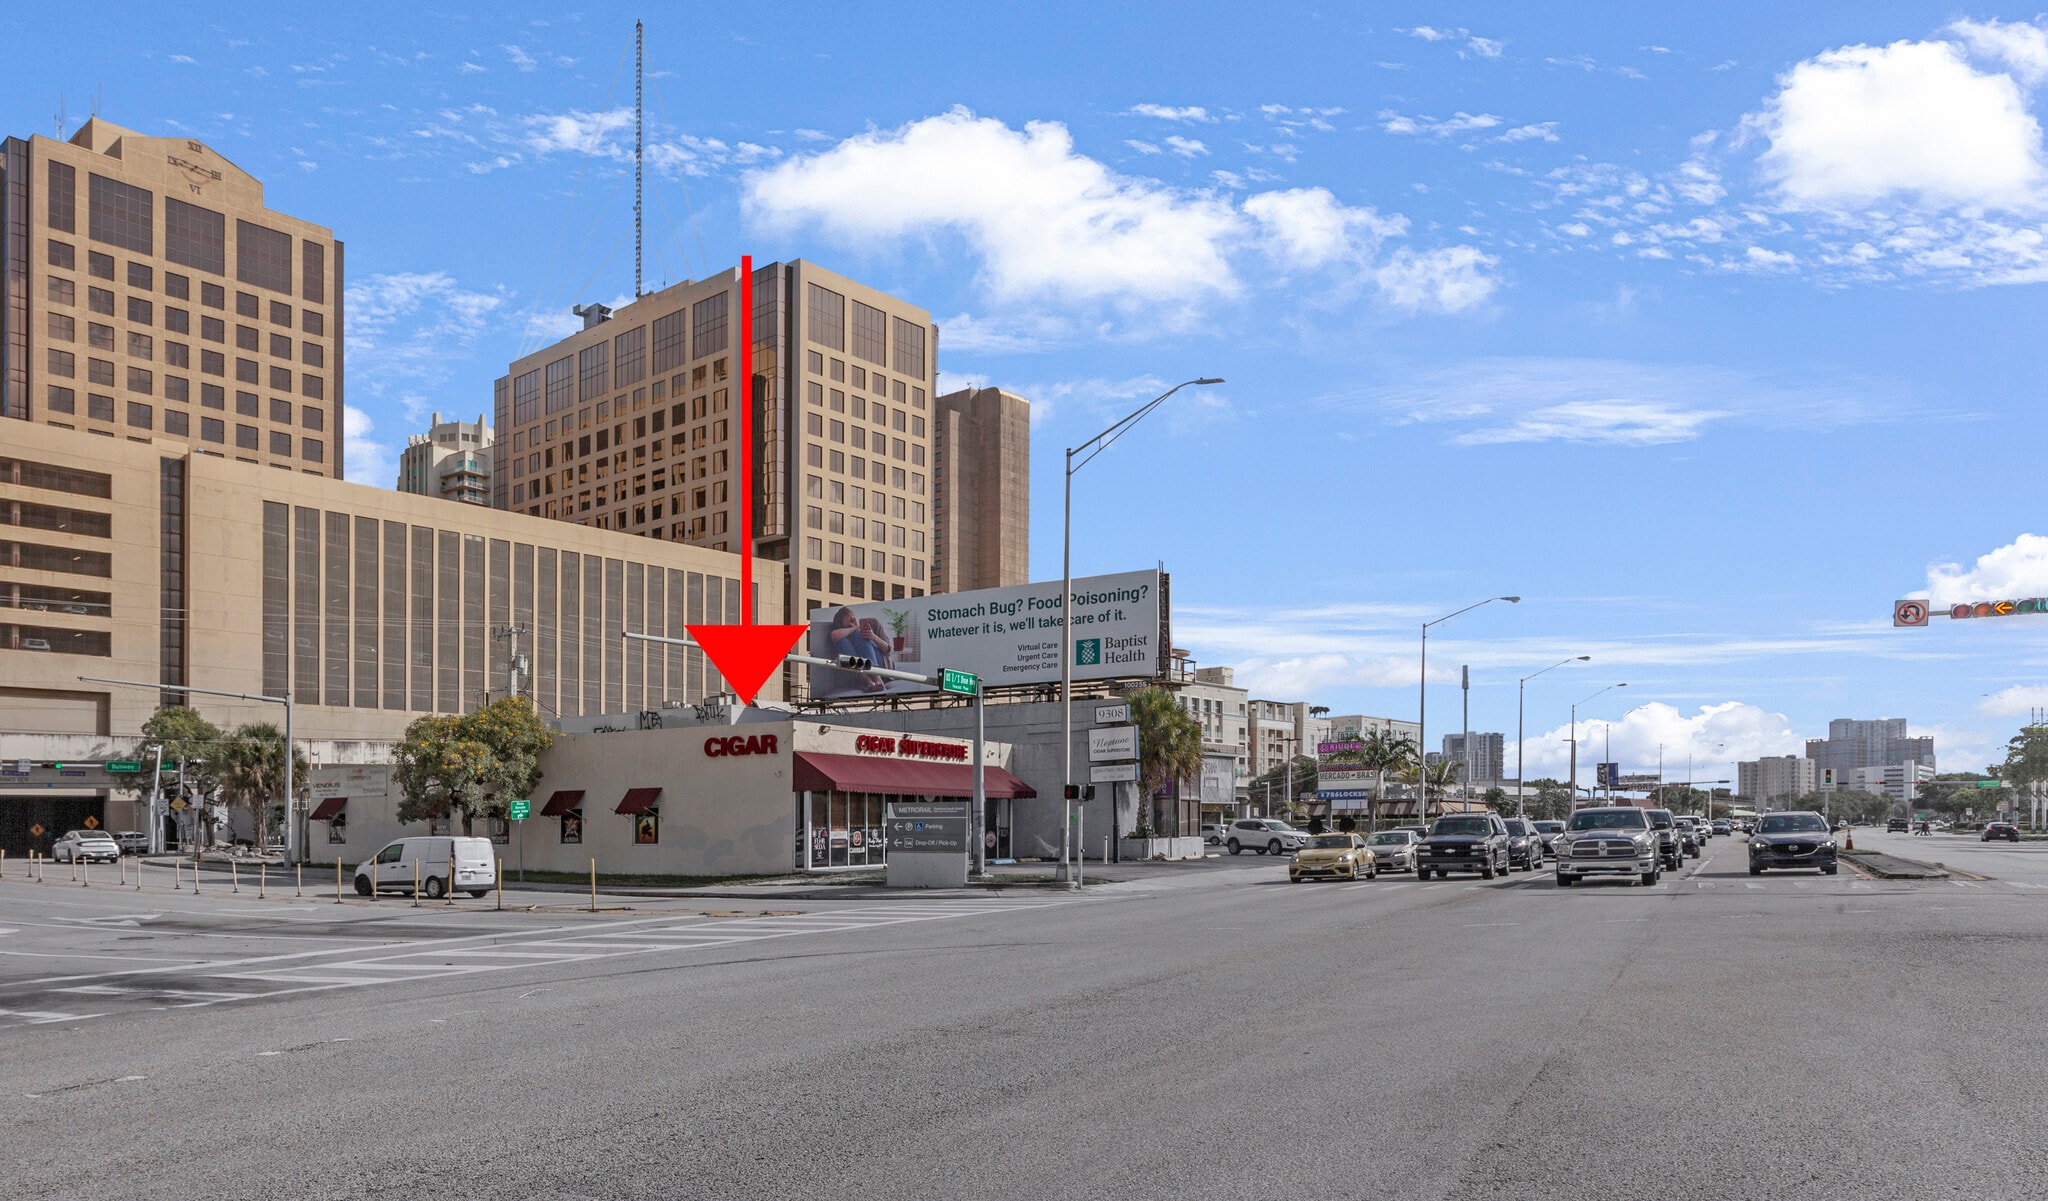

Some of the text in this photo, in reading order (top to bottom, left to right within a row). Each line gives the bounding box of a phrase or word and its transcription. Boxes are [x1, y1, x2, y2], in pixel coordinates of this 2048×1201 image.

[188, 141, 202, 153] XII
[189, 184, 201, 195] VI
[928, 585, 1148, 621] Stomach Bug? Food Poisoning?
[927, 609, 1127, 639] Whatever it is, we'll take care of it.
[1017, 642, 1058, 652] Virtual Care
[1105, 634, 1148, 650] Baptist
[1017, 653, 1040, 662] Urgent
[1105, 649, 1145, 664] Health
[1002, 661, 1058, 673] Emergency Care
[1098, 708, 1124, 718] 9308
[704, 734, 778, 758] CIGAR
[856, 734, 968, 759] CIGAR SUPERSTORE
[1093, 738, 1129, 749] Neptune
